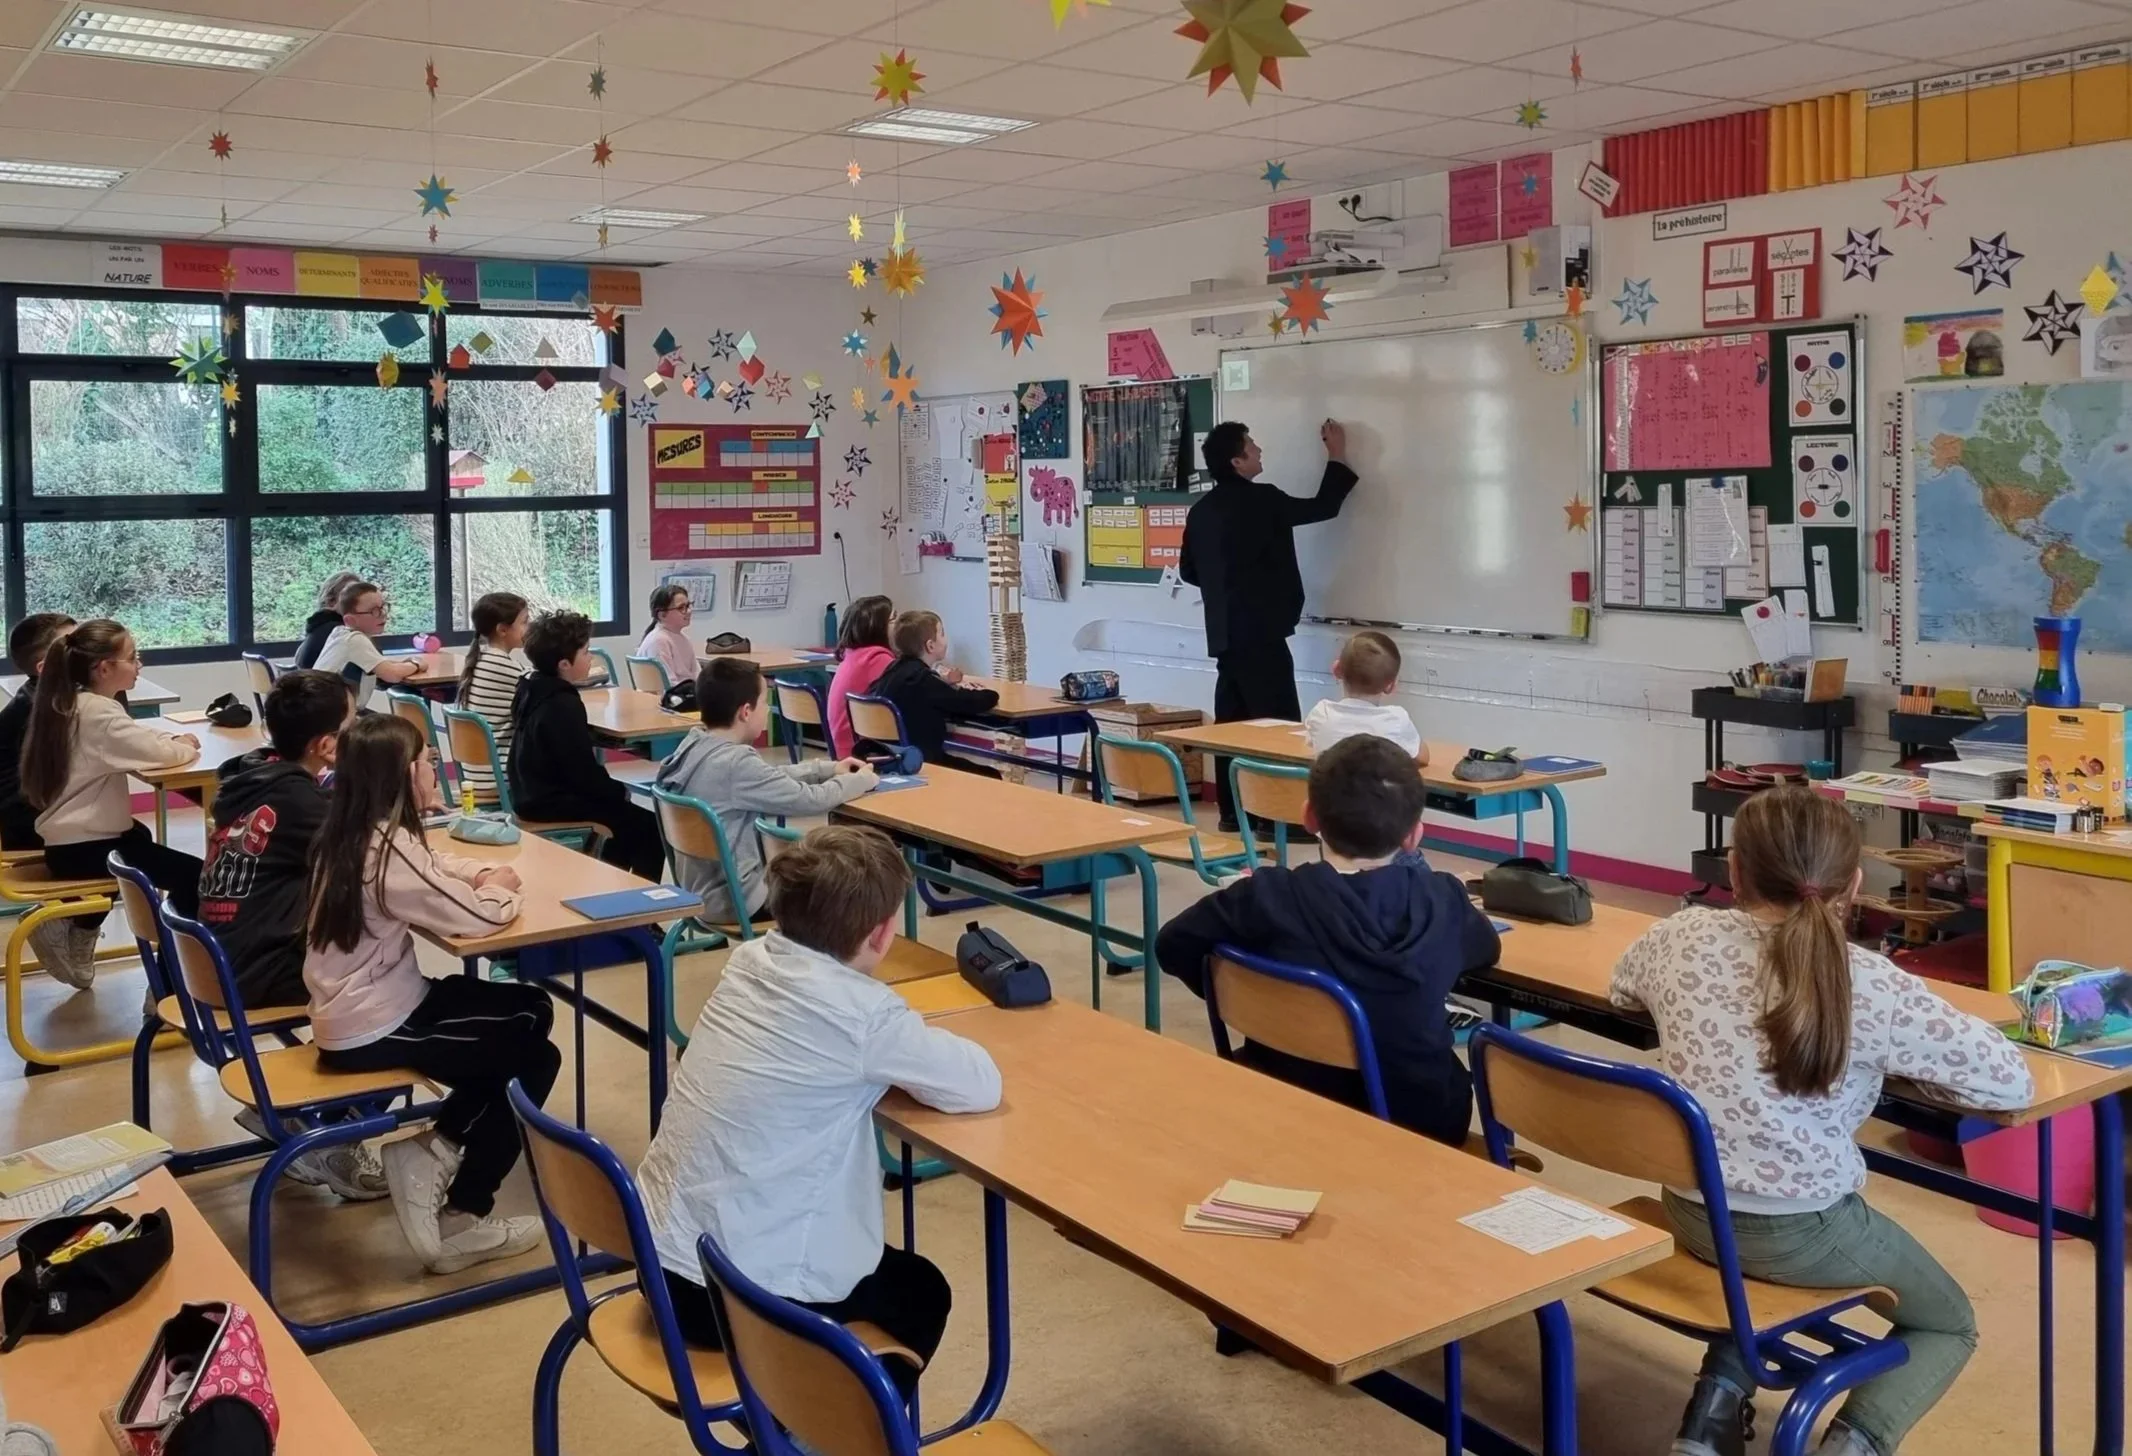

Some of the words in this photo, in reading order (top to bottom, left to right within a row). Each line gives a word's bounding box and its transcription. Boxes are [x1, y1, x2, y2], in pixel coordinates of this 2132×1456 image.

[1669, 212, 1722, 231] préhistoire
[173, 261, 219, 273] VERBES
[246, 266, 280, 277] NOMS
[104, 272, 152, 284] NATURE
[480, 278, 534, 290] ADVERBES
[657, 434, 702, 464] MESURES
[1806, 441, 1839, 449] LECTURE
